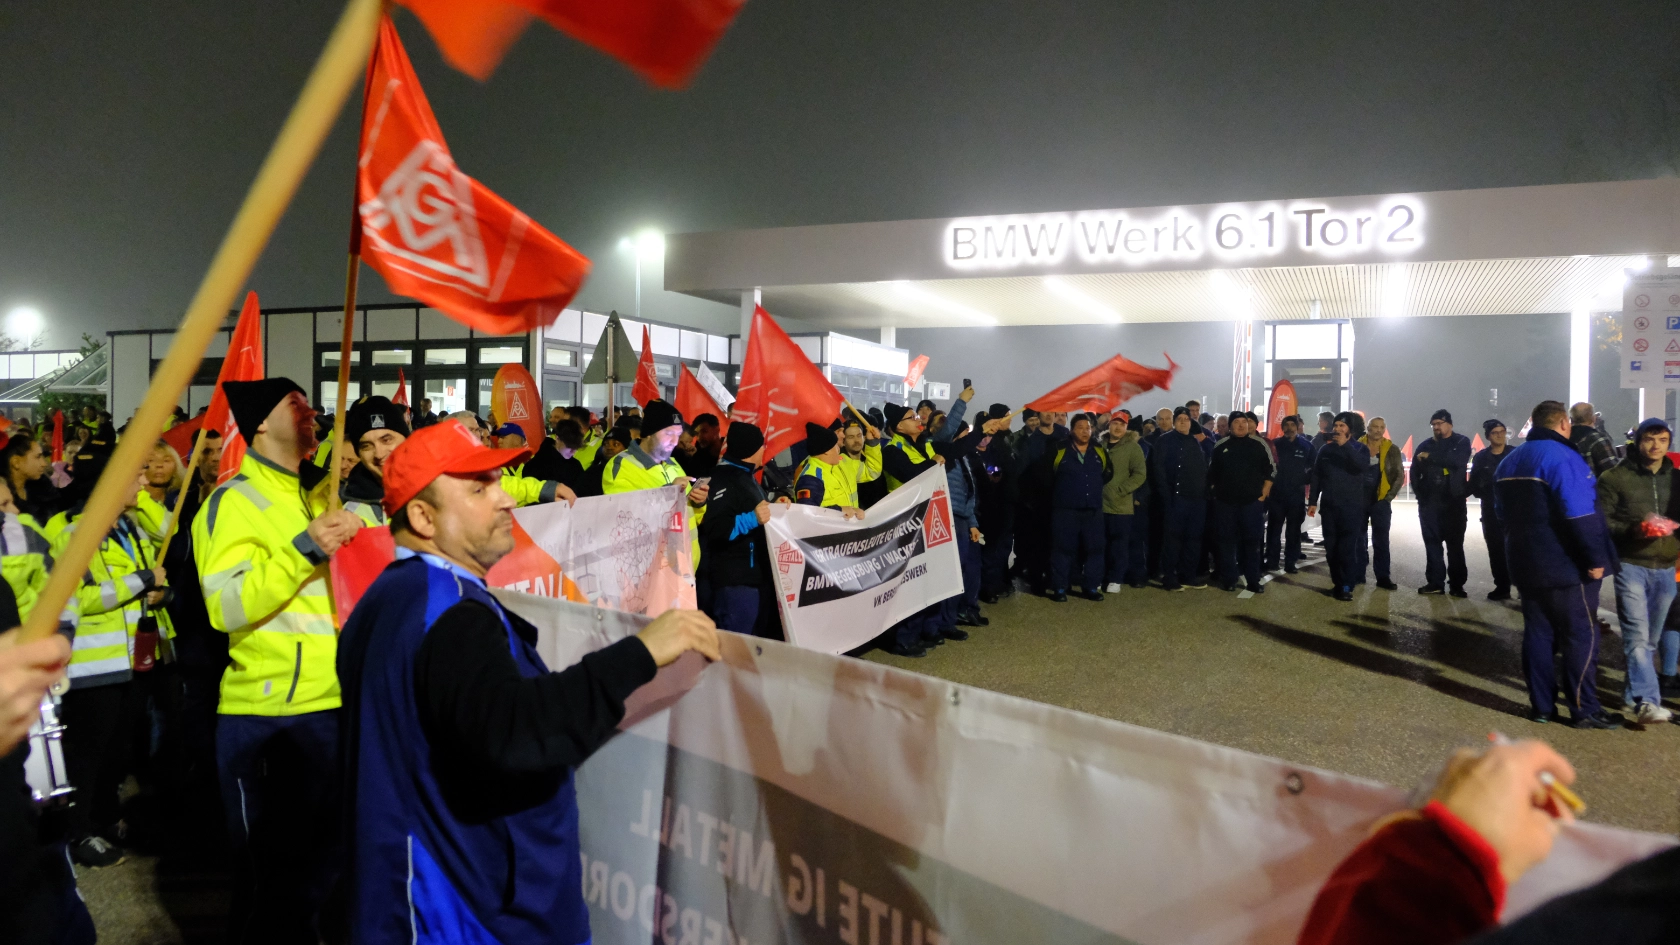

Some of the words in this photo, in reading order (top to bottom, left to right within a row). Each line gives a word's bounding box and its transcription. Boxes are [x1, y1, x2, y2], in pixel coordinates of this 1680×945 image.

[952, 222, 1063, 260] BMW
[1081, 216, 1197, 256] Werk
[1215, 211, 1277, 249] 6.1
[1294, 208, 1371, 247] Tor
[1386, 204, 1415, 242] 2
[892, 516, 923, 539] METAL
